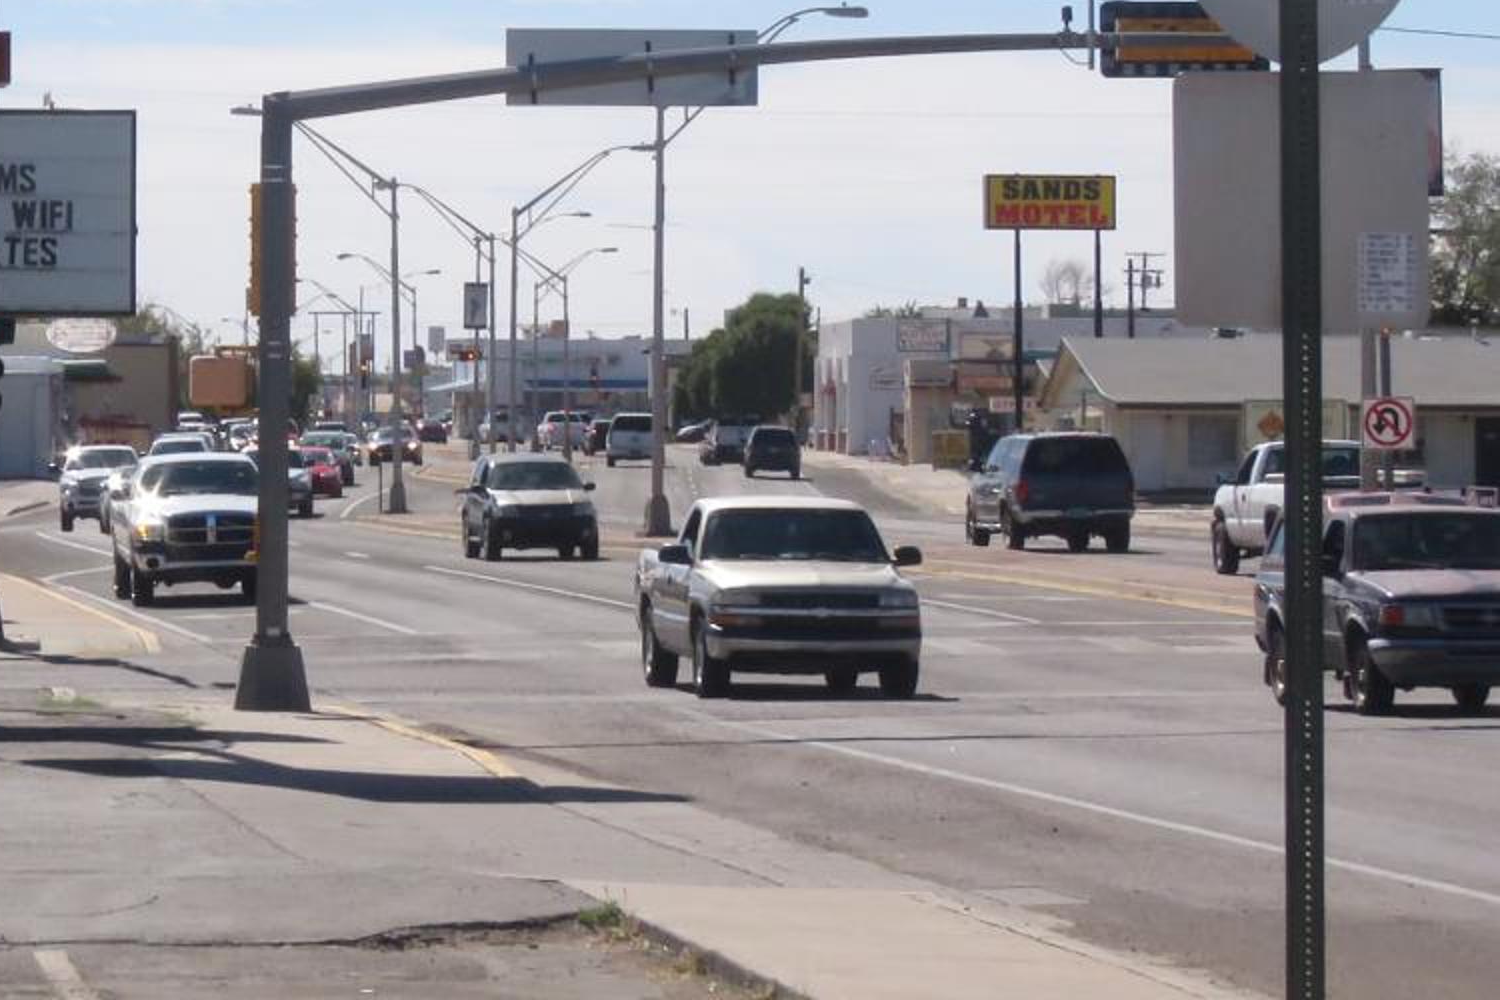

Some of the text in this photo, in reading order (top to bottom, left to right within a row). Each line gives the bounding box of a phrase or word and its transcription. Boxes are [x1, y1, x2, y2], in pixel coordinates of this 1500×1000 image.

[1002, 179, 1101, 200] SANDS
[13, 201, 74, 230] WIFI
[995, 203, 1109, 226] MOTEL
